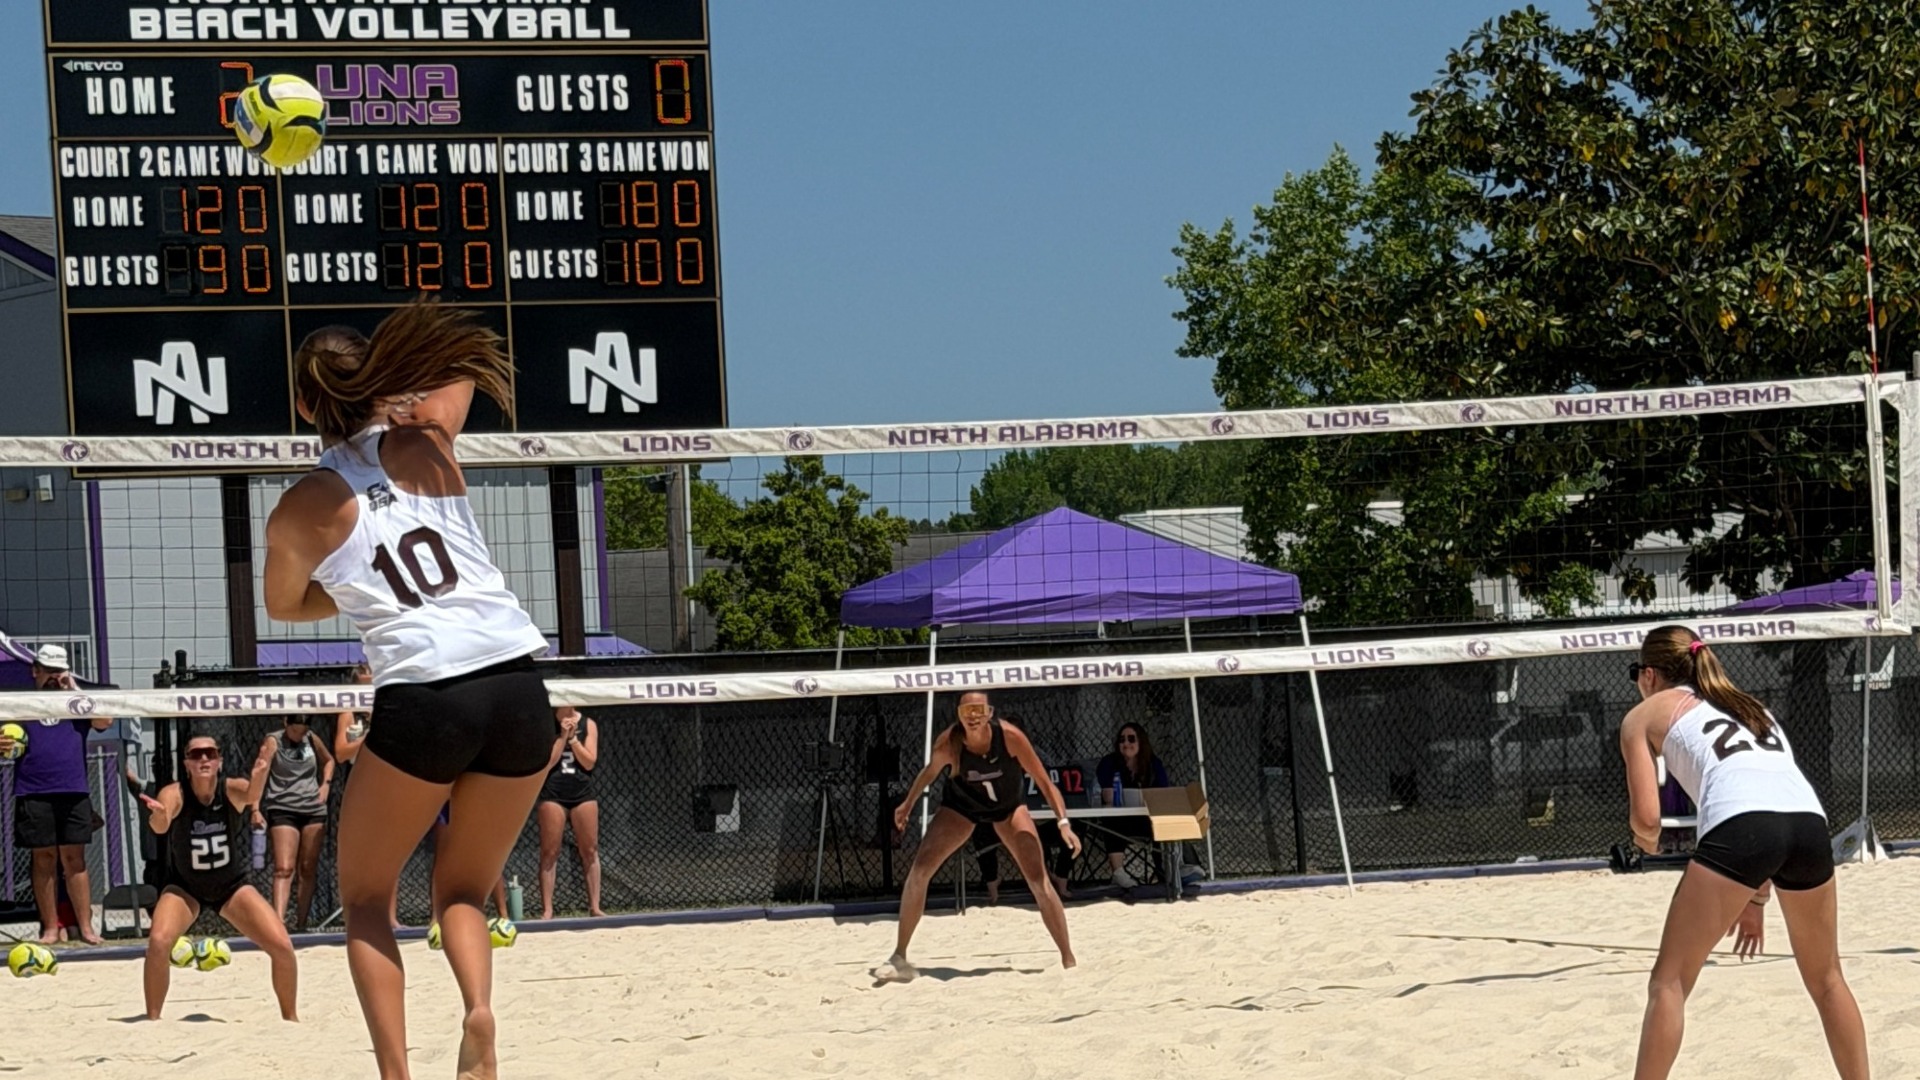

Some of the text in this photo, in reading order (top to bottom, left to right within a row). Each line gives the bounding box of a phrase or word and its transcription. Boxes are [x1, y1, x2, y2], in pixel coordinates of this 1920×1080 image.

[129, 7, 631, 40] BEACH VOLLEYBALL
[73, 61, 123, 72] NEVCO
[316, 64, 460, 99] UNA
[85, 76, 176, 116] HOME
[219, 61, 254, 129] 2
[516, 74, 630, 112] GUESTS
[655, 58, 692, 125] 0
[324, 100, 461, 126] LIONS
[60, 146, 131, 178] COURT
[139, 146, 154, 177] 2
[157, 145, 221, 177] GAME
[281, 143, 499, 176] URT 1 GAME WON
[503, 141, 710, 173] COURT 3 GAME WON
[73, 196, 145, 227] HOME
[294, 193, 364, 224] HOME
[516, 190, 584, 221] HOME
[65, 256, 159, 287] GUESTS
[286, 252, 378, 283] GUESTS
[509, 249, 598, 279] GUESTS
[1555, 385, 1792, 417] NORTH ALABAMA
[888, 420, 1139, 446] NORTH ALABAMA
[1306, 409, 1390, 429] LIONS
[171, 442, 279, 459] NORTH
[622, 434, 712, 452] LIONS
[371, 525, 459, 609] 10
[1560, 620, 1796, 650] NORTH ABAMA
[1311, 646, 1396, 665] LIONS
[628, 681, 718, 699] LIONS
[894, 660, 1145, 689] NORTH ALABAMA
[177, 692, 375, 711] NORTH ALAB
[561, 751, 576, 774] 2
[982, 781, 998, 801] 1
[1062, 769, 1084, 792] 12
[191, 834, 230, 870] 25
